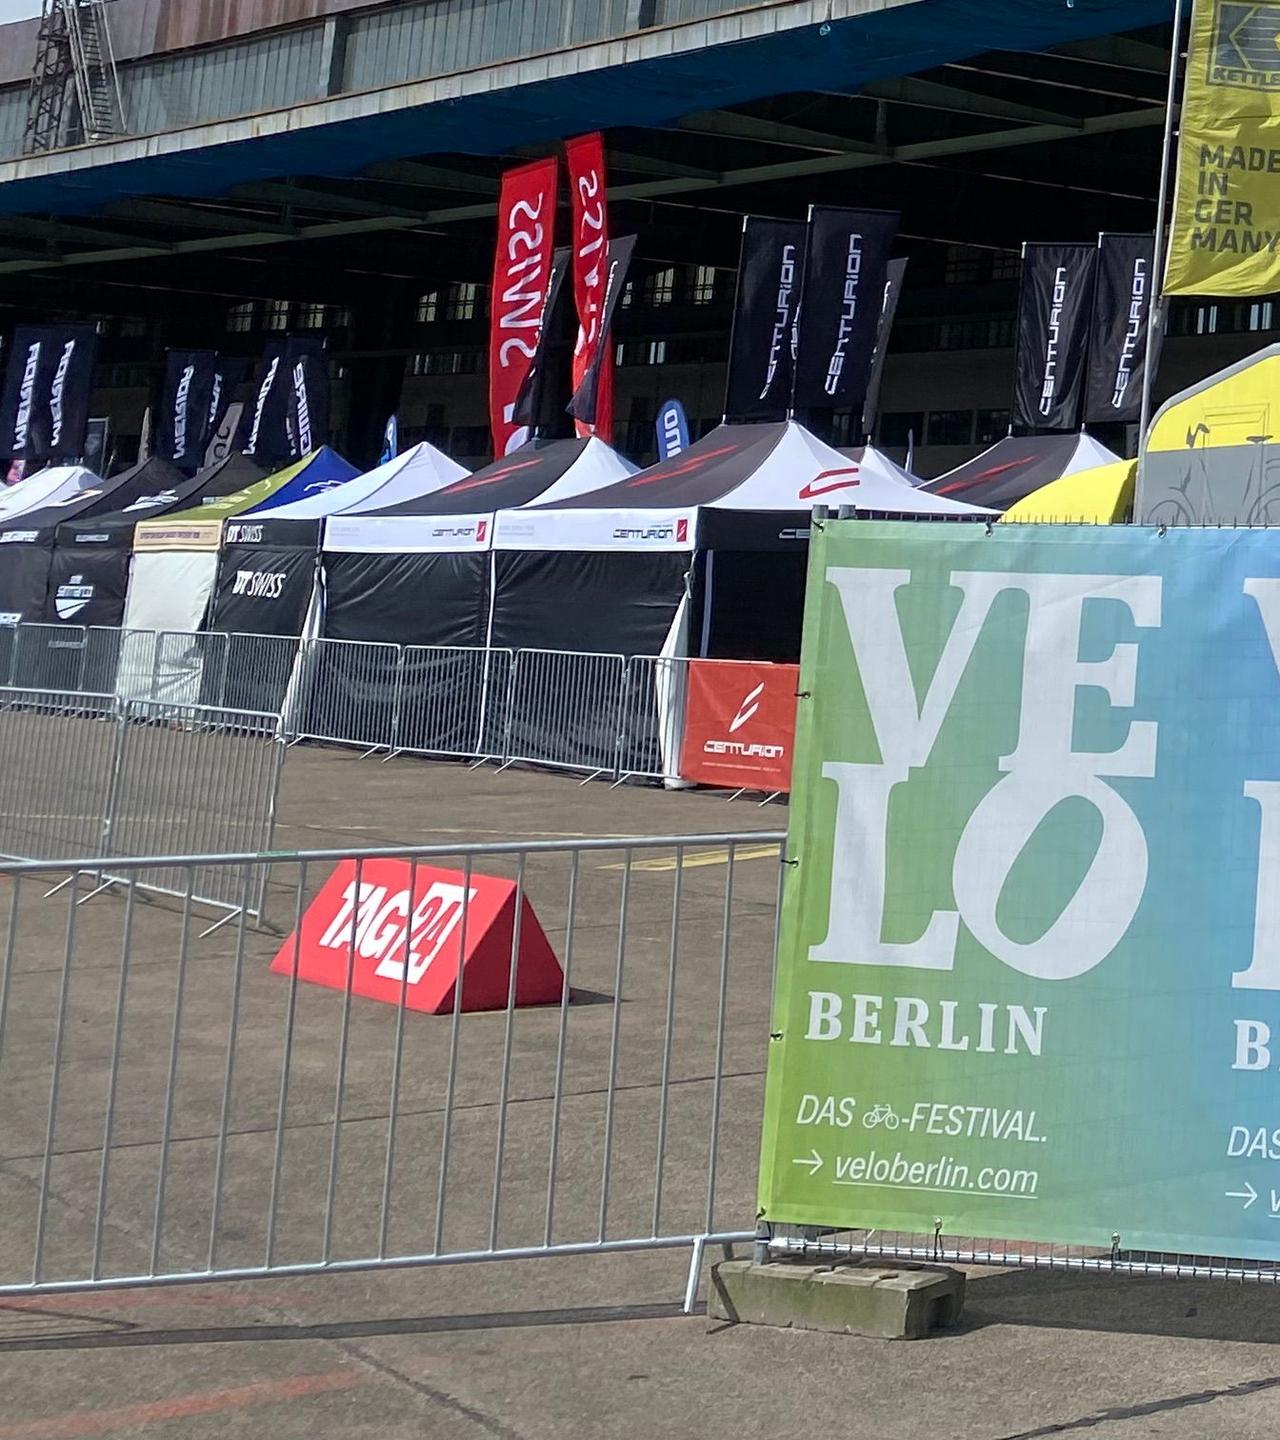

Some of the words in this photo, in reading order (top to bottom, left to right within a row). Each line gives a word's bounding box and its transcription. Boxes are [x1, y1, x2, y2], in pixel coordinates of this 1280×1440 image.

[1198, 171, 1228, 195] IN
[1194, 198, 1254, 226] GER
[824, 234, 863, 395] CENTURION
[1111, 258, 1146, 408] CENTURION
[1039, 267, 1066, 416] CENTURION
[612, 528, 673, 540] CENTURION
[247, 571, 287, 599] SWISS
[826, 566, 1162, 778] VE
[704, 740, 784, 758] CENTURION
[807, 763, 1149, 980] LO
[804, 991, 1048, 1056] BERLIN
[795, 1094, 856, 1127] DAS
[834, 1151, 1038, 1195] veloberlin.com
